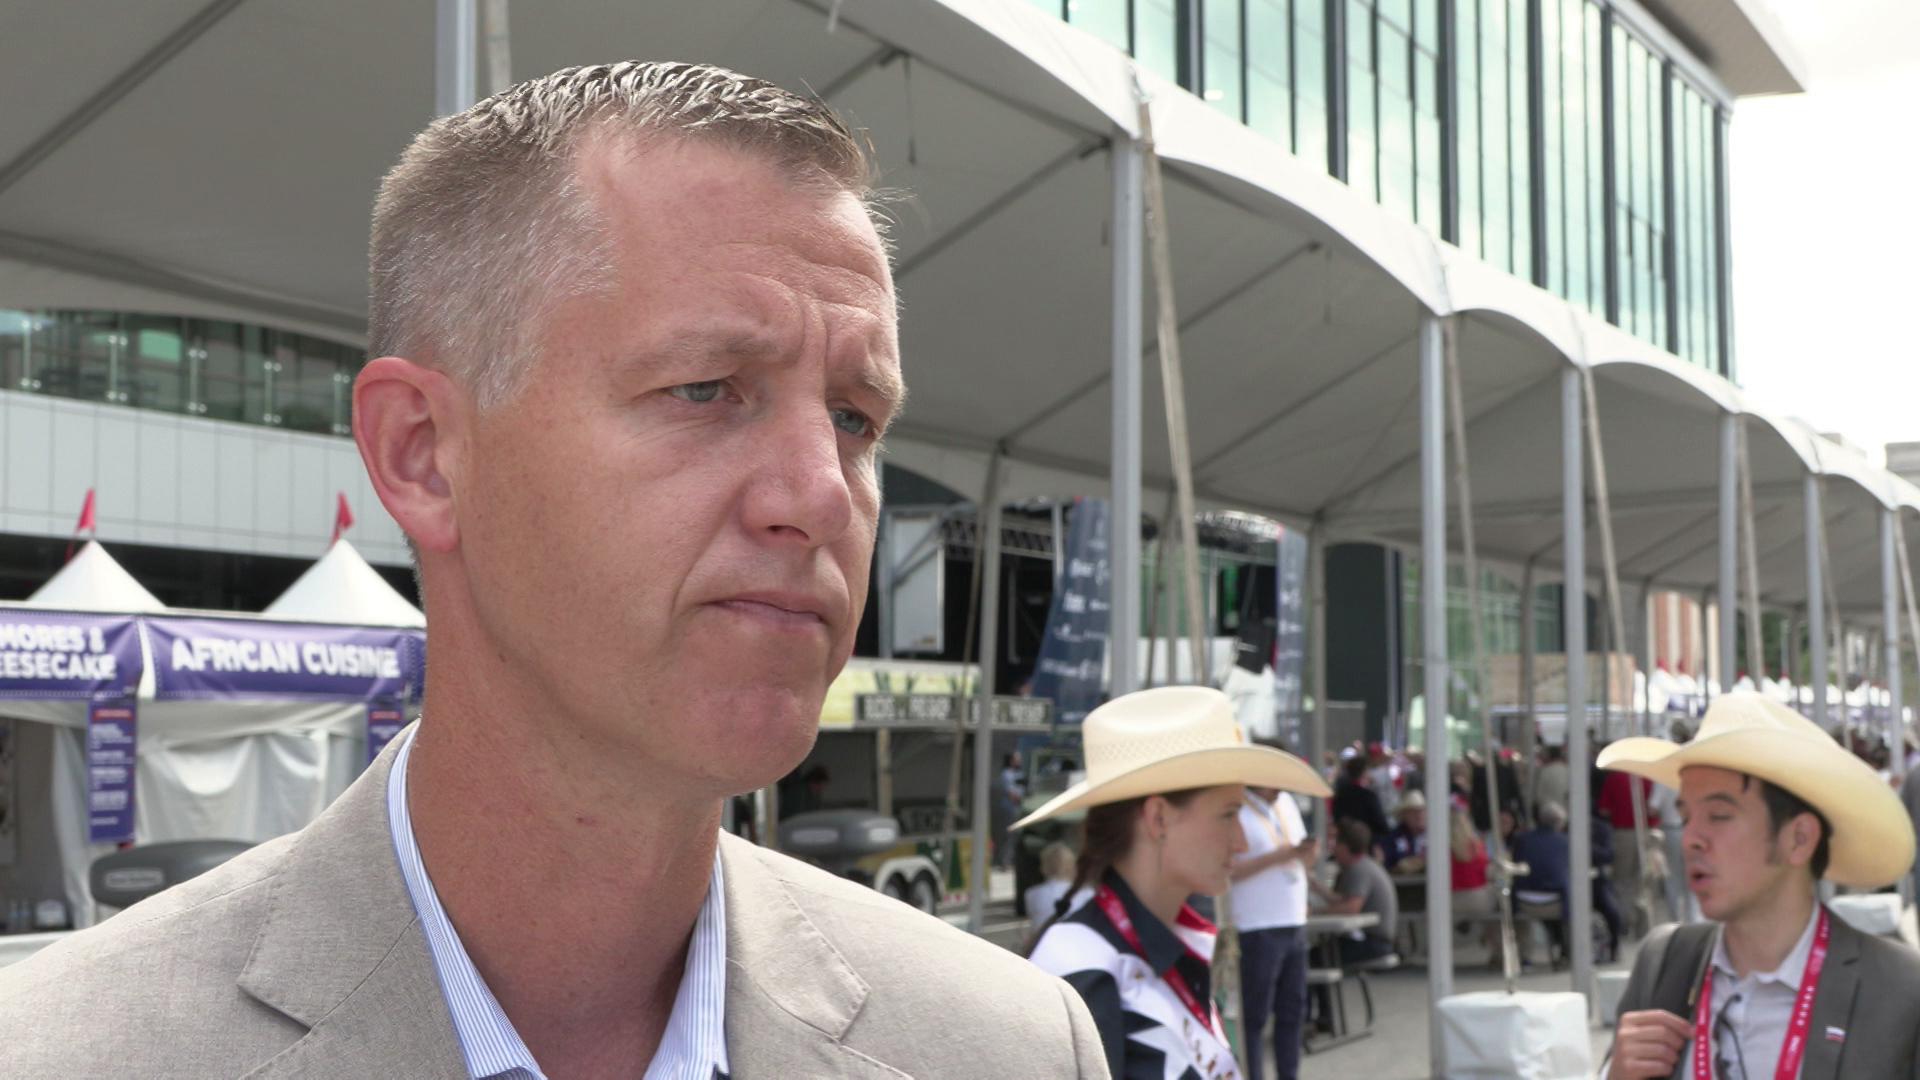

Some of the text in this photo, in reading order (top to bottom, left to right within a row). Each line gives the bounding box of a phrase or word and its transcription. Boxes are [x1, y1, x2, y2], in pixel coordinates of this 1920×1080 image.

[89, 626, 106, 653] &
[0, 651, 118, 680] ESECAKE
[172, 637, 401, 679] AFRICAN CUISINE
